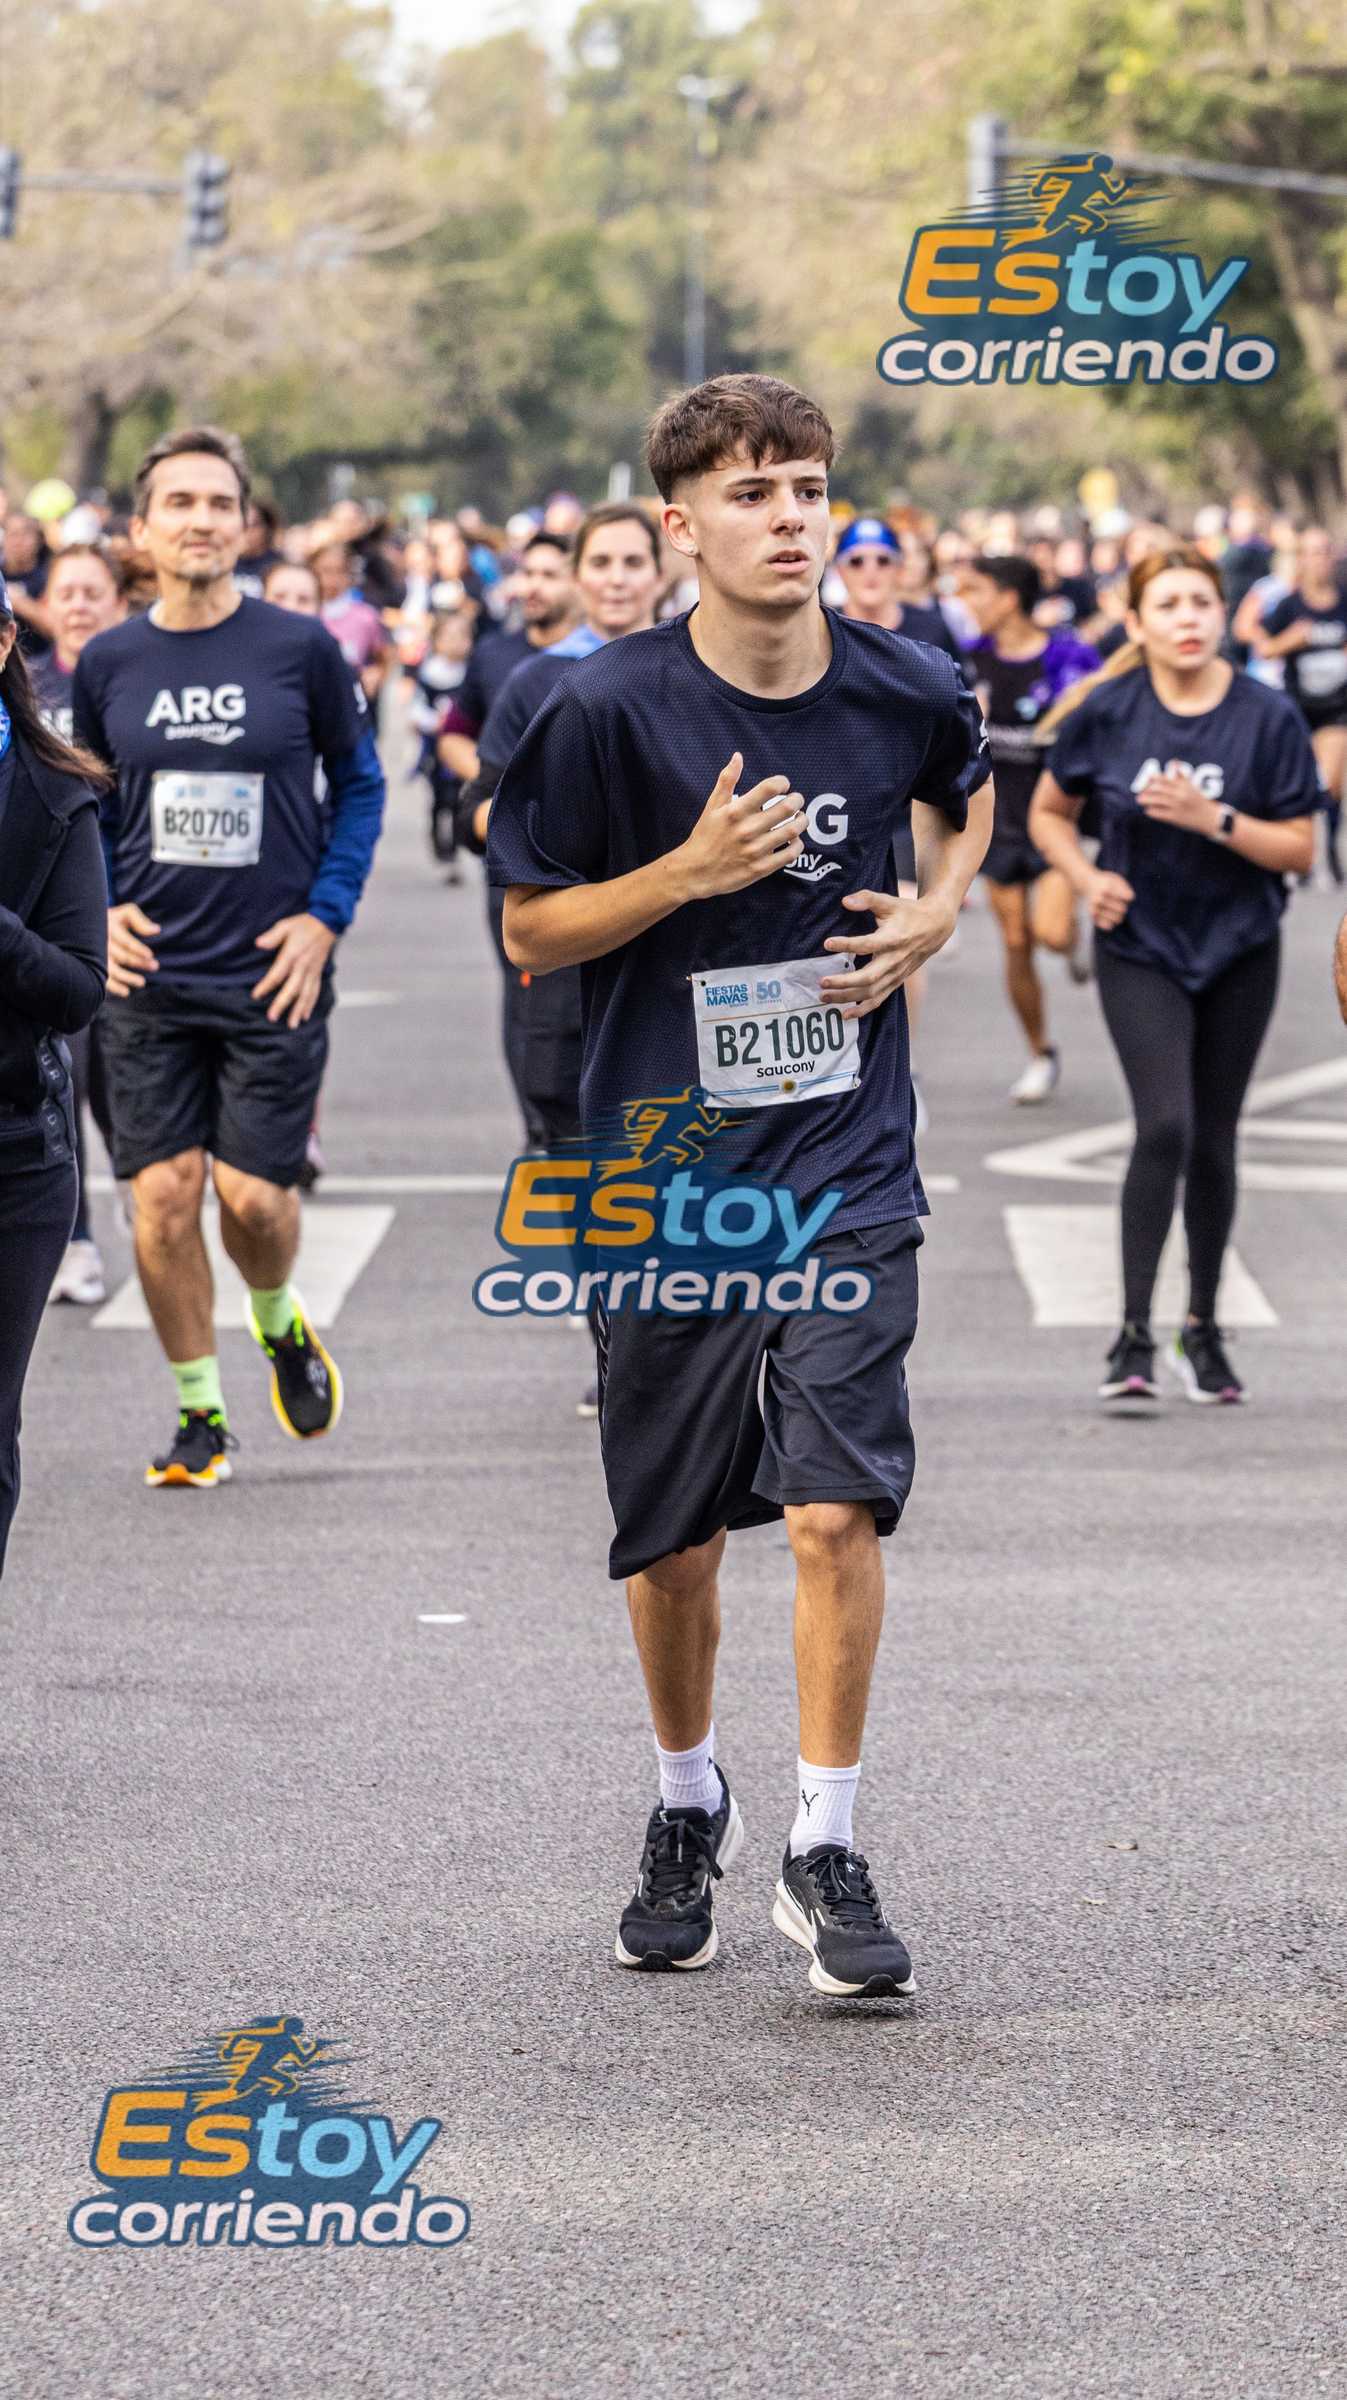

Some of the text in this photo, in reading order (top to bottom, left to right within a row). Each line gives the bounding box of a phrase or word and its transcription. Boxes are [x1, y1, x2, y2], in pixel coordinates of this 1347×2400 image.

[144, 683, 246, 728] ARG
[164, 806, 250, 838] B20706
[705, 983, 748, 996] FIESTAS
[756, 980, 781, 1000] 50
[706, 993, 749, 1007] MAYAS
[715, 1007, 845, 1068] B21060
[756, 1060, 816, 1078] saucony
